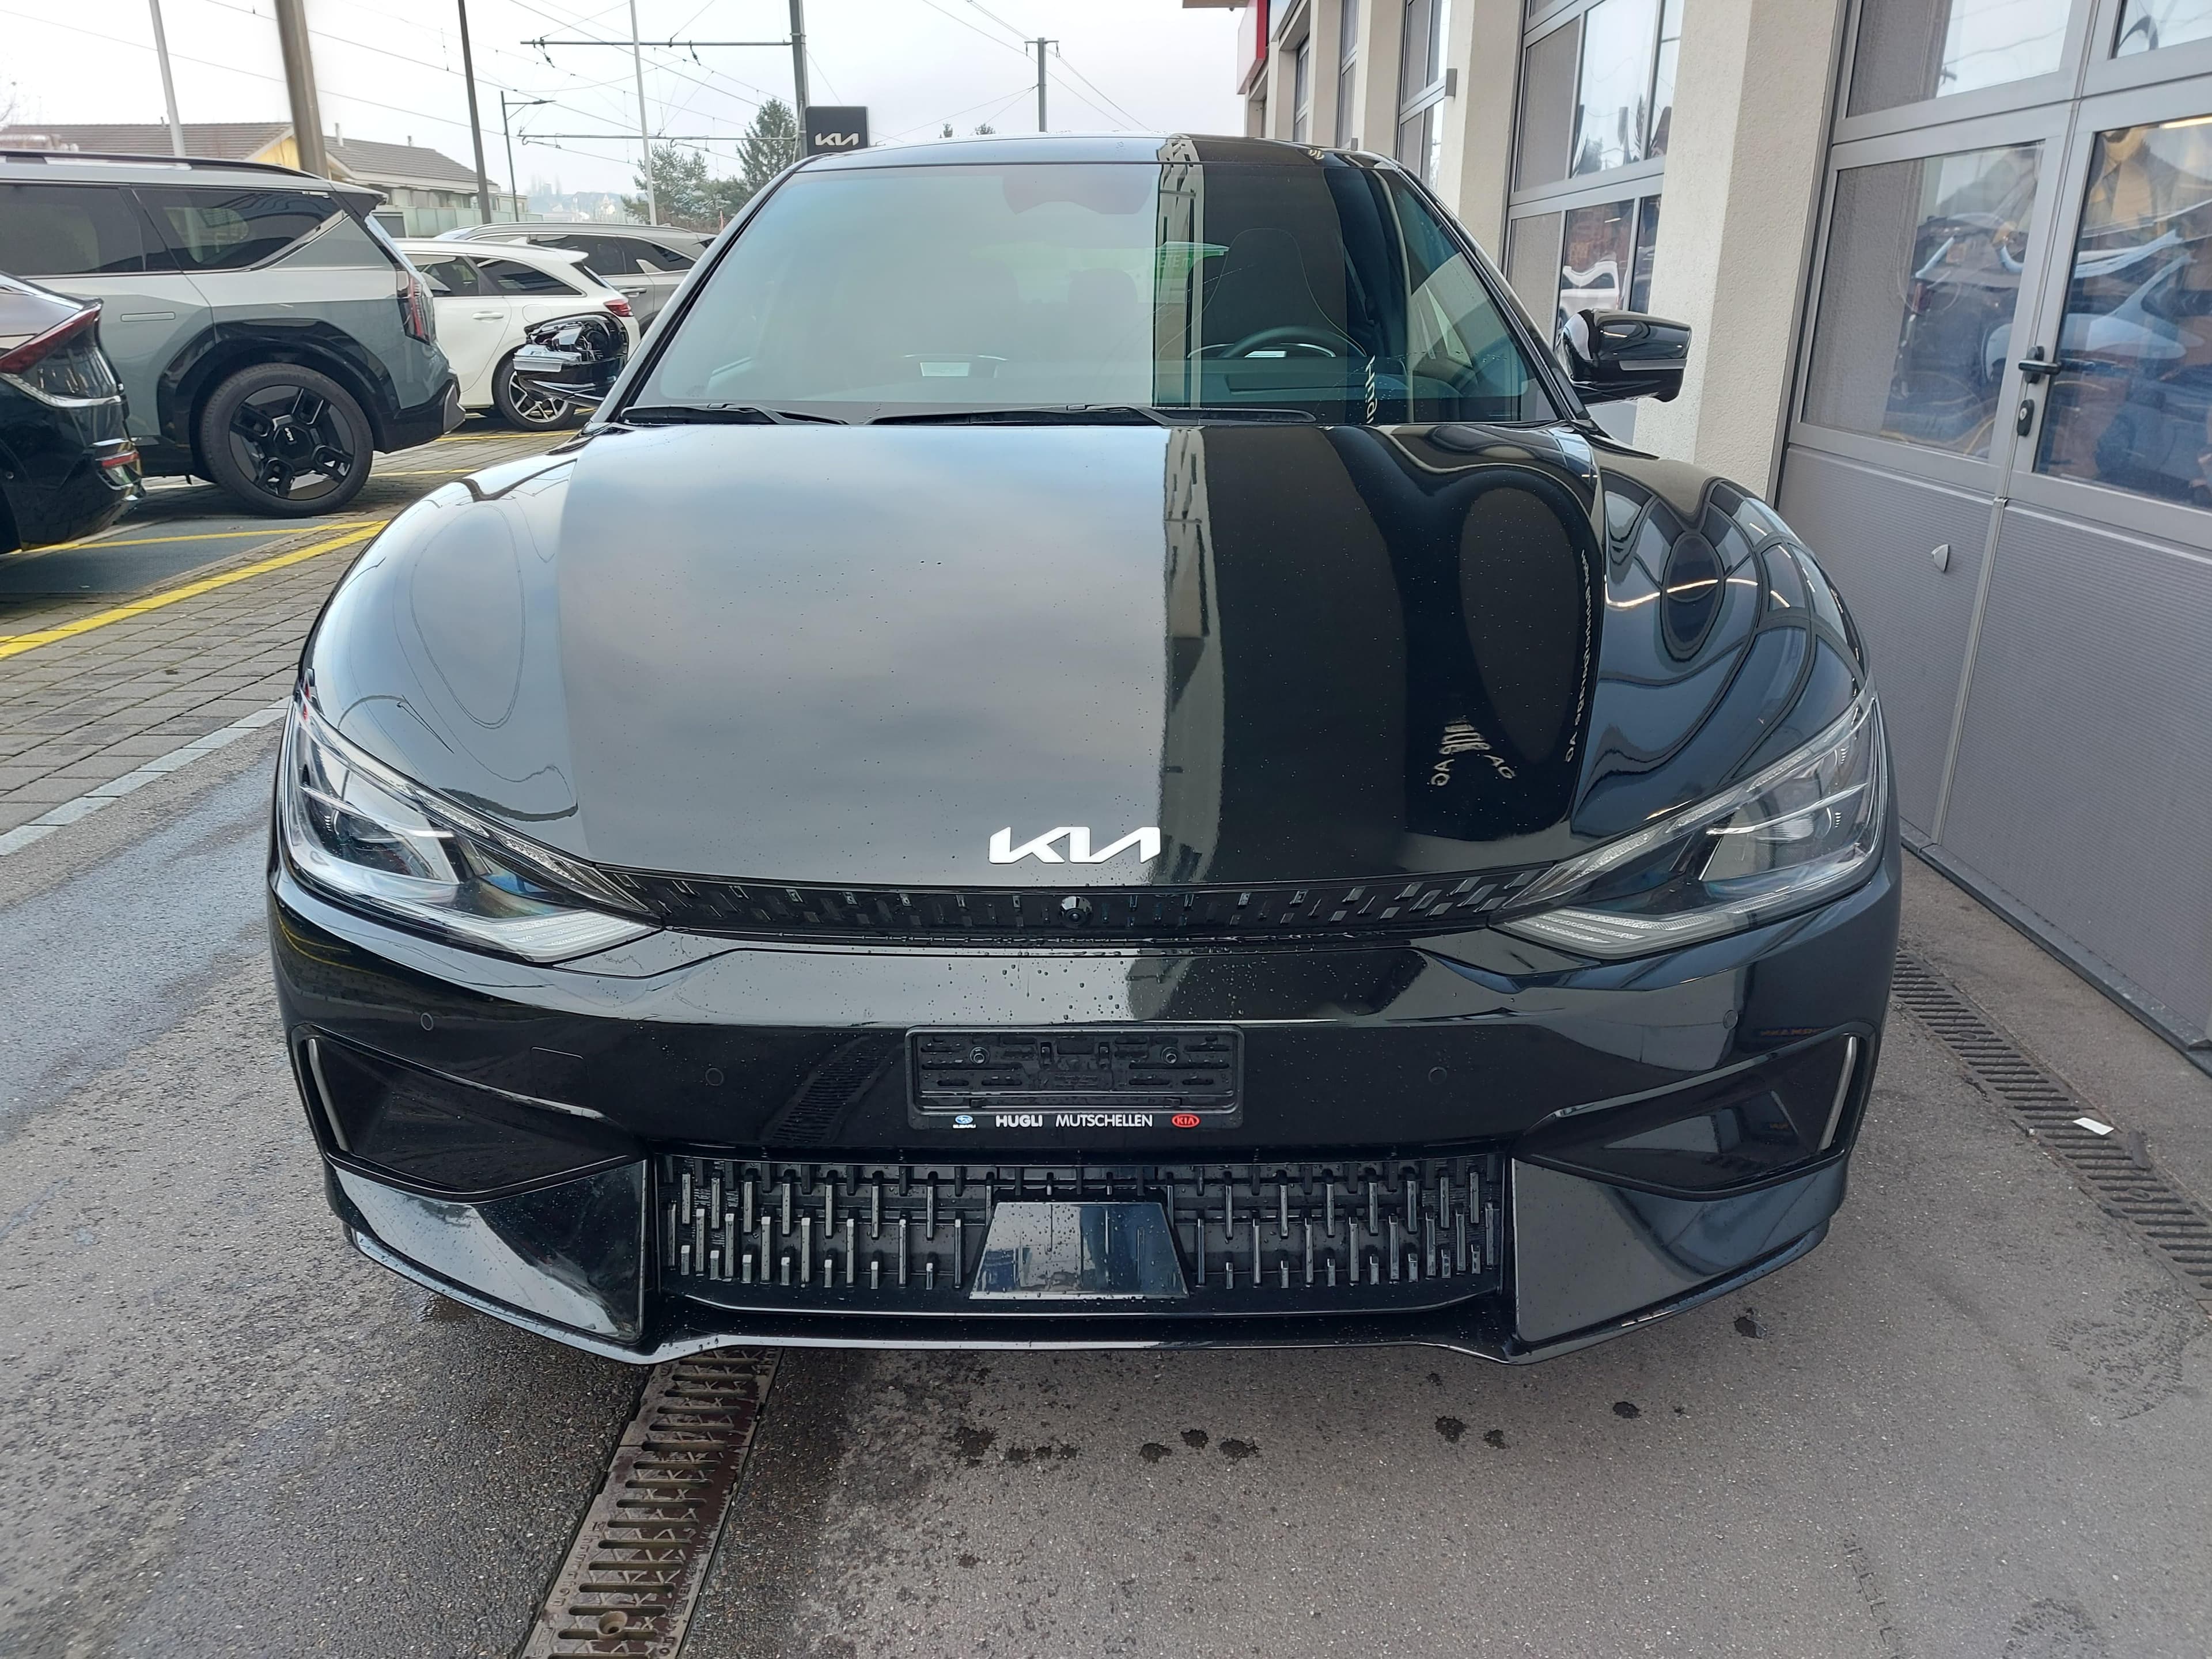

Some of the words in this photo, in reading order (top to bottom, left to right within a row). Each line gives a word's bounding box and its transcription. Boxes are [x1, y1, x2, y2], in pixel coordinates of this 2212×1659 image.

[815, 132, 859, 146] KIA
[988, 826, 1161, 864] KIA
[1055, 1114, 1153, 1127] MUTSCHELLEN
[1175, 1115, 1196, 1126] KIA
